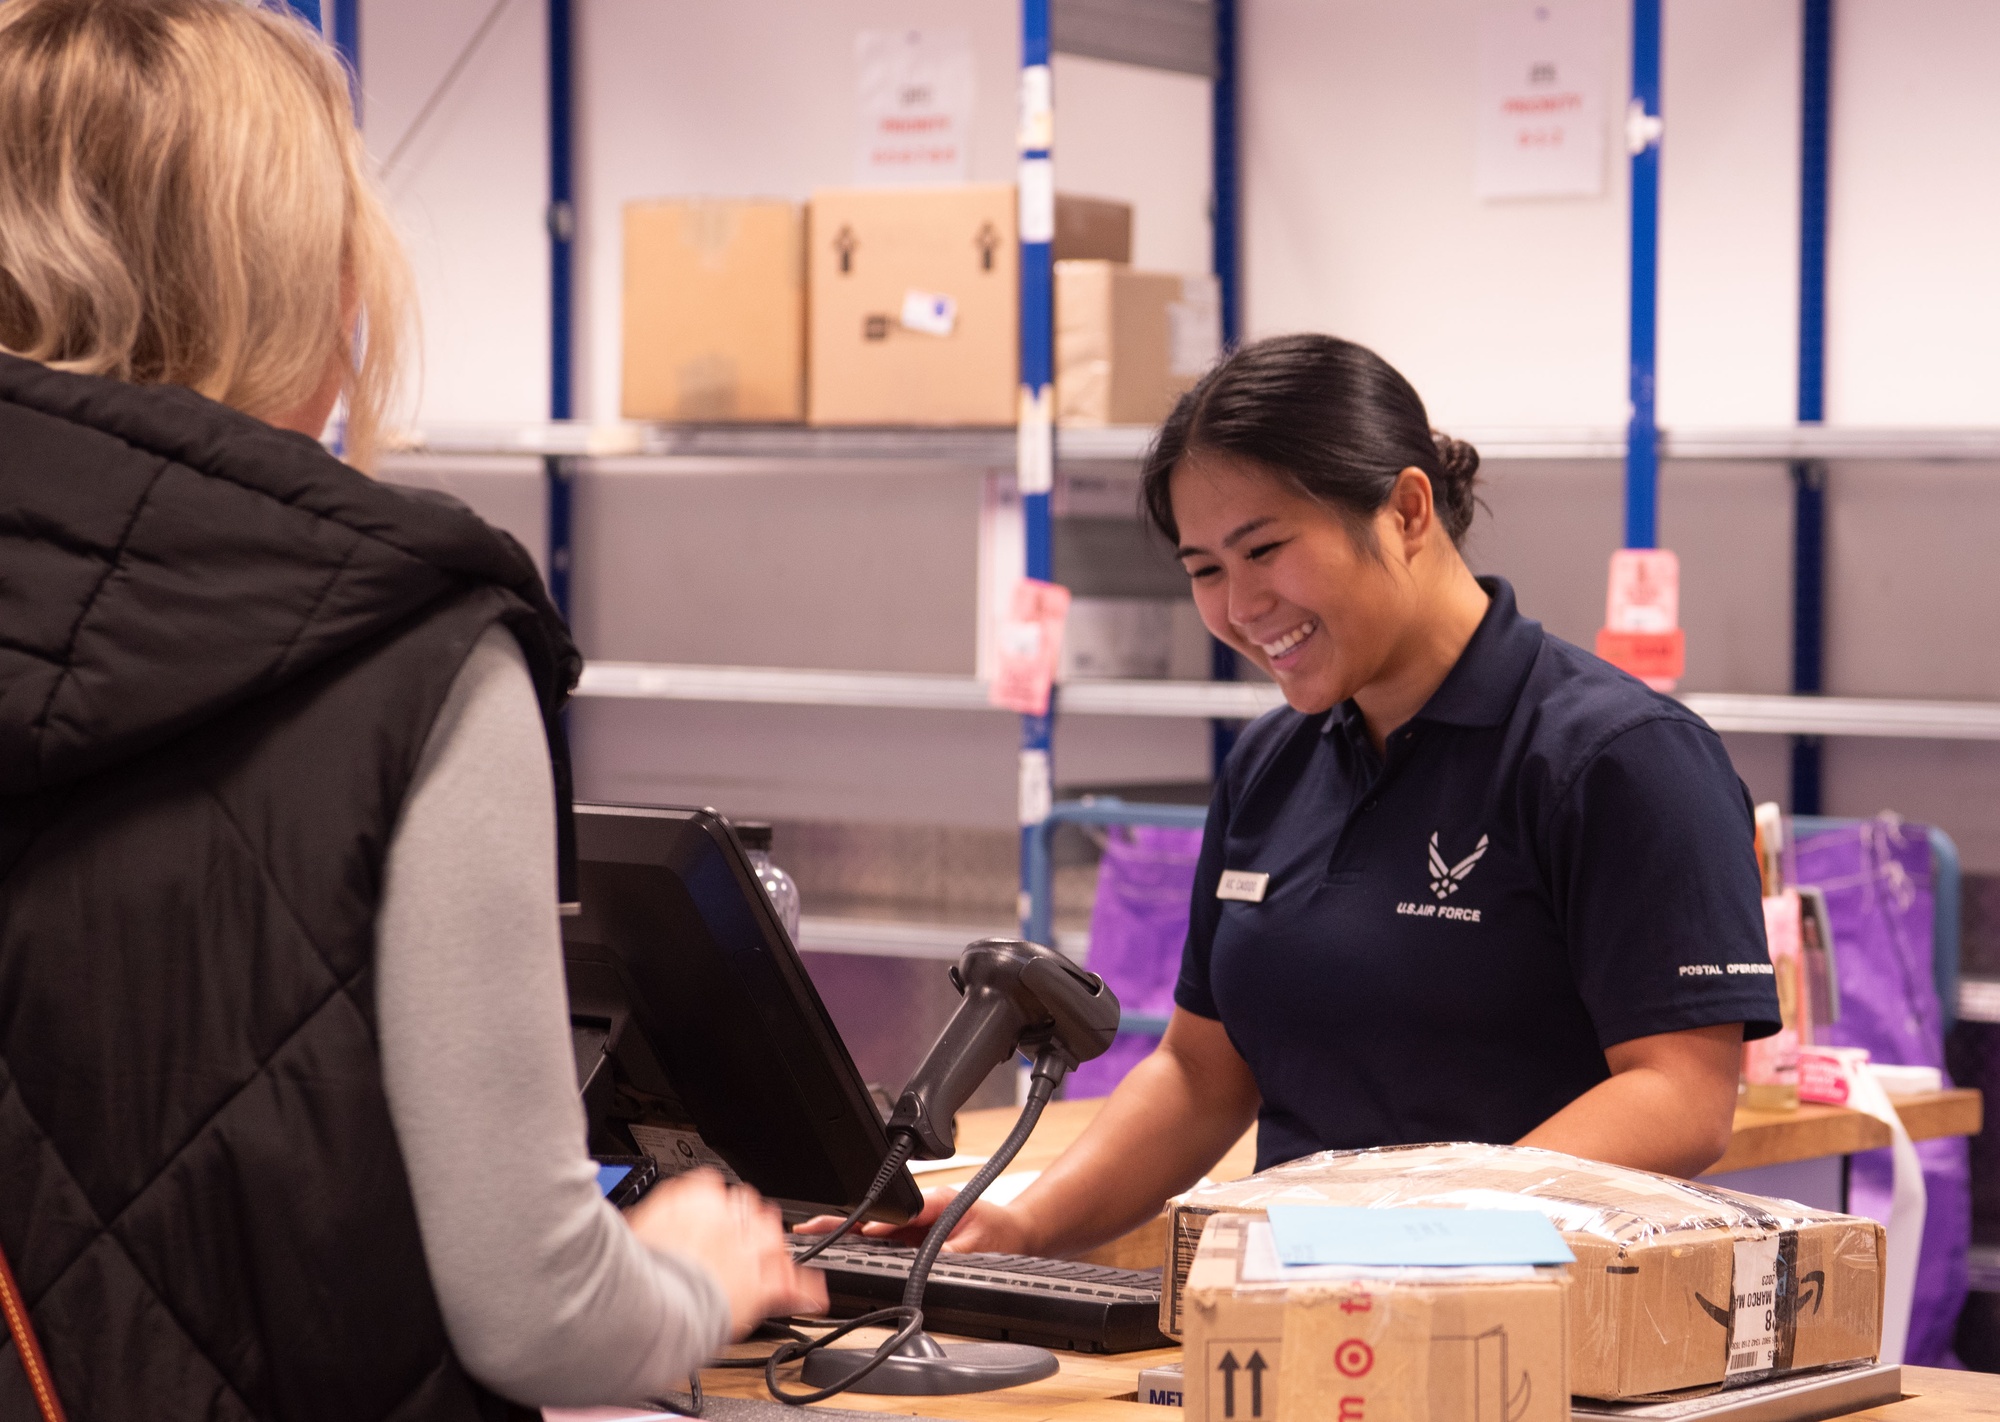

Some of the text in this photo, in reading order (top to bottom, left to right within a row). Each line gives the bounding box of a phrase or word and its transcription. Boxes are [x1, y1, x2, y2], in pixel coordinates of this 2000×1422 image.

[1437, 905, 1482, 922] FORCE
[1678, 964, 1723, 976] POSTAL
[1761, 1274, 1775, 1286] 2023
[1747, 1290, 1772, 1308] MARCO
